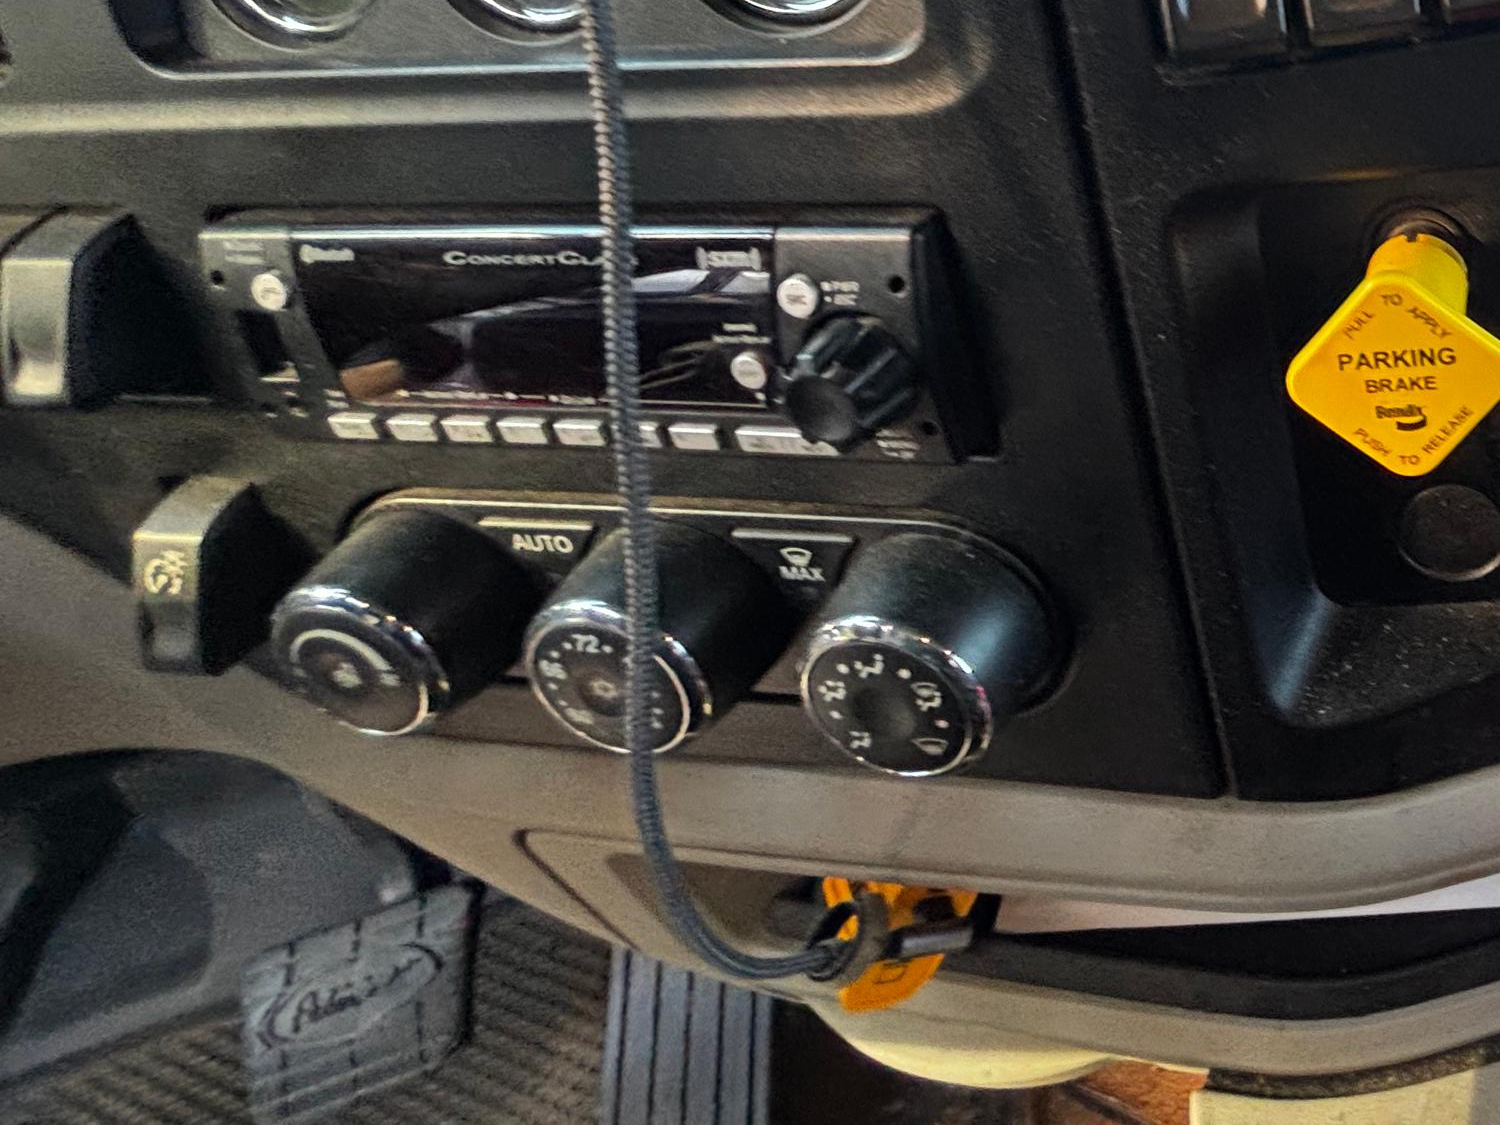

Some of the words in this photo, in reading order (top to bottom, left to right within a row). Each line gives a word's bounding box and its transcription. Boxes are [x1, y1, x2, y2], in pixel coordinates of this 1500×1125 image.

[1343, 309, 1376, 340] PULL
[1381, 293, 1403, 306] TO
[1406, 306, 1453, 339] APPLY
[1337, 346, 1457, 372] PARKING
[1364, 375, 1438, 395] BRAKE
[1353, 427, 1393, 456] PUSH
[1399, 454, 1421, 466] TO
[1420, 405, 1474, 455] RELEASE
[512, 533, 574, 554] AUTO
[778, 565, 826, 582] MAX
[571, 633, 602, 654] 72
